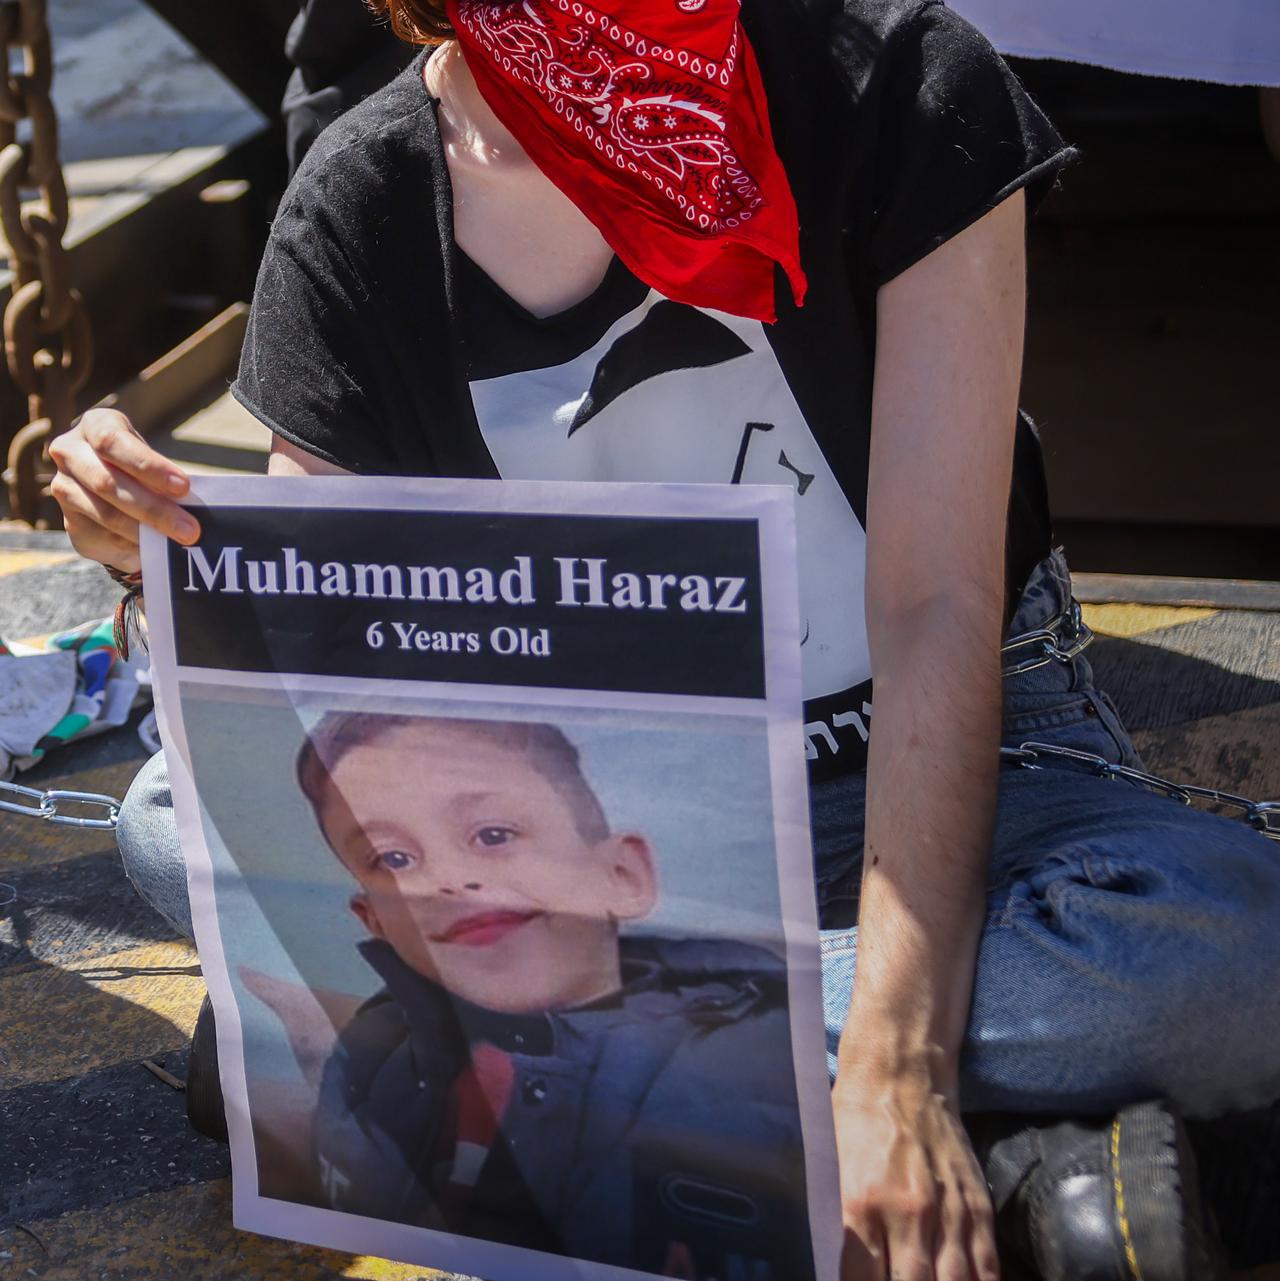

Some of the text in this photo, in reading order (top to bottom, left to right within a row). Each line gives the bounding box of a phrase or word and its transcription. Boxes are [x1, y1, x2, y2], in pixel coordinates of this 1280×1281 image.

[183, 545, 748, 613] Muhammad Haraz
[366, 621, 551, 657] 6 Years Old
